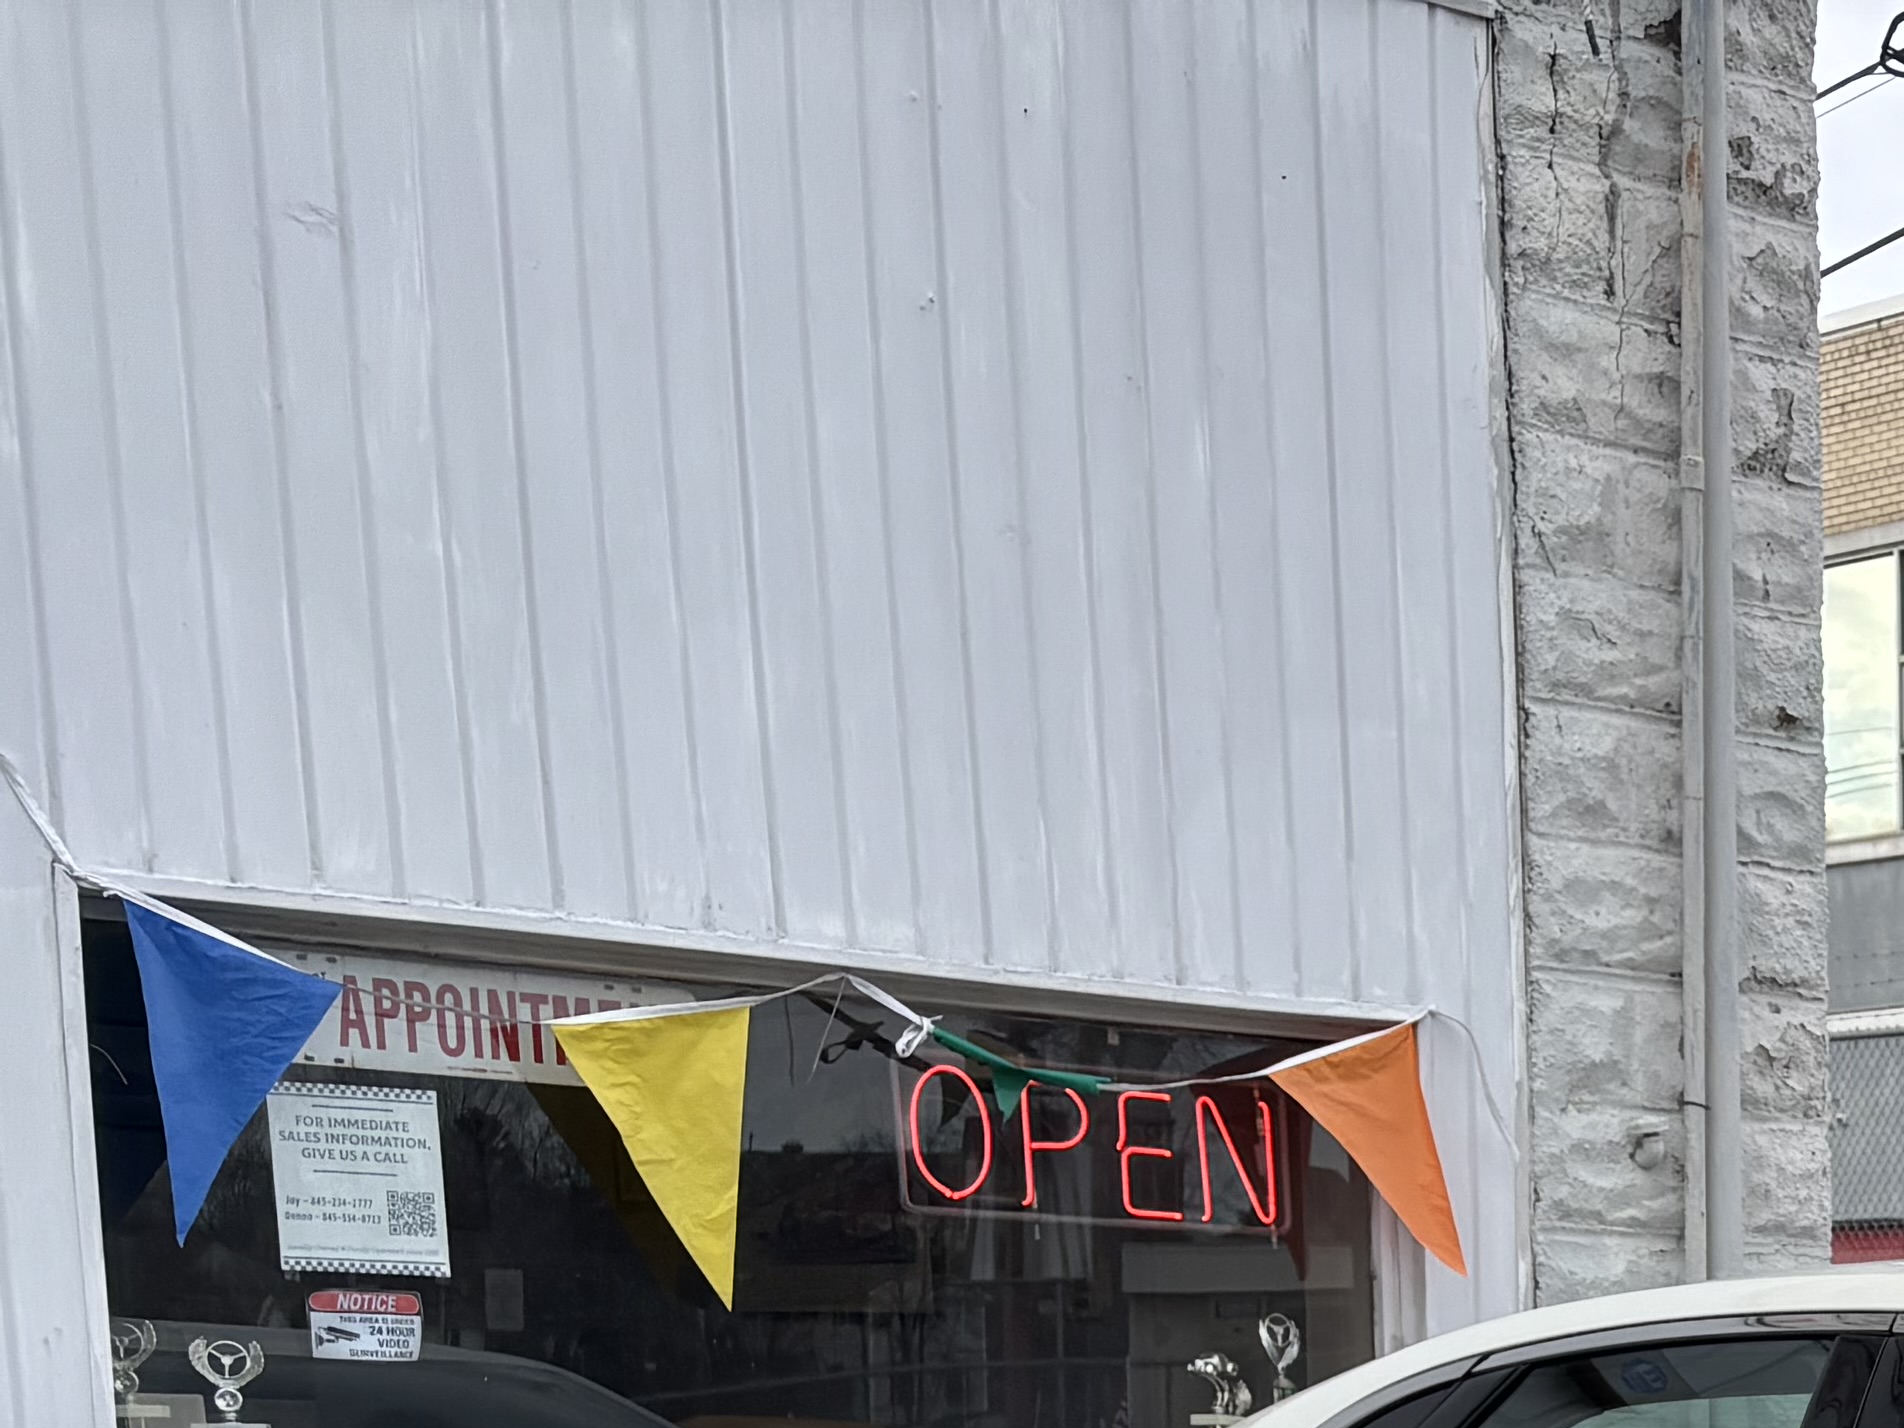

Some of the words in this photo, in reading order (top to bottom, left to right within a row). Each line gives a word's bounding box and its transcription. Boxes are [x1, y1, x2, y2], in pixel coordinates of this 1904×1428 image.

[295, 1114, 324, 1128] FOR
[328, 1116, 410, 1133] IMMEDIATE
[278, 1130, 321, 1143] SALES
[325, 1132, 432, 1151] INFORMATION,
[909, 1063, 1279, 1225] OPEN
[301, 1147, 336, 1160] GIVE
[339, 1149, 358, 1162] US
[360, 1151, 370, 1162] A
[374, 1151, 409, 1164] CALL
[337, 1293, 397, 1312] NOTICE
[368, 1325, 383, 1336] 24
[386, 1326, 416, 1338] HOUR
[377, 1338, 410, 1349] VIDEO
